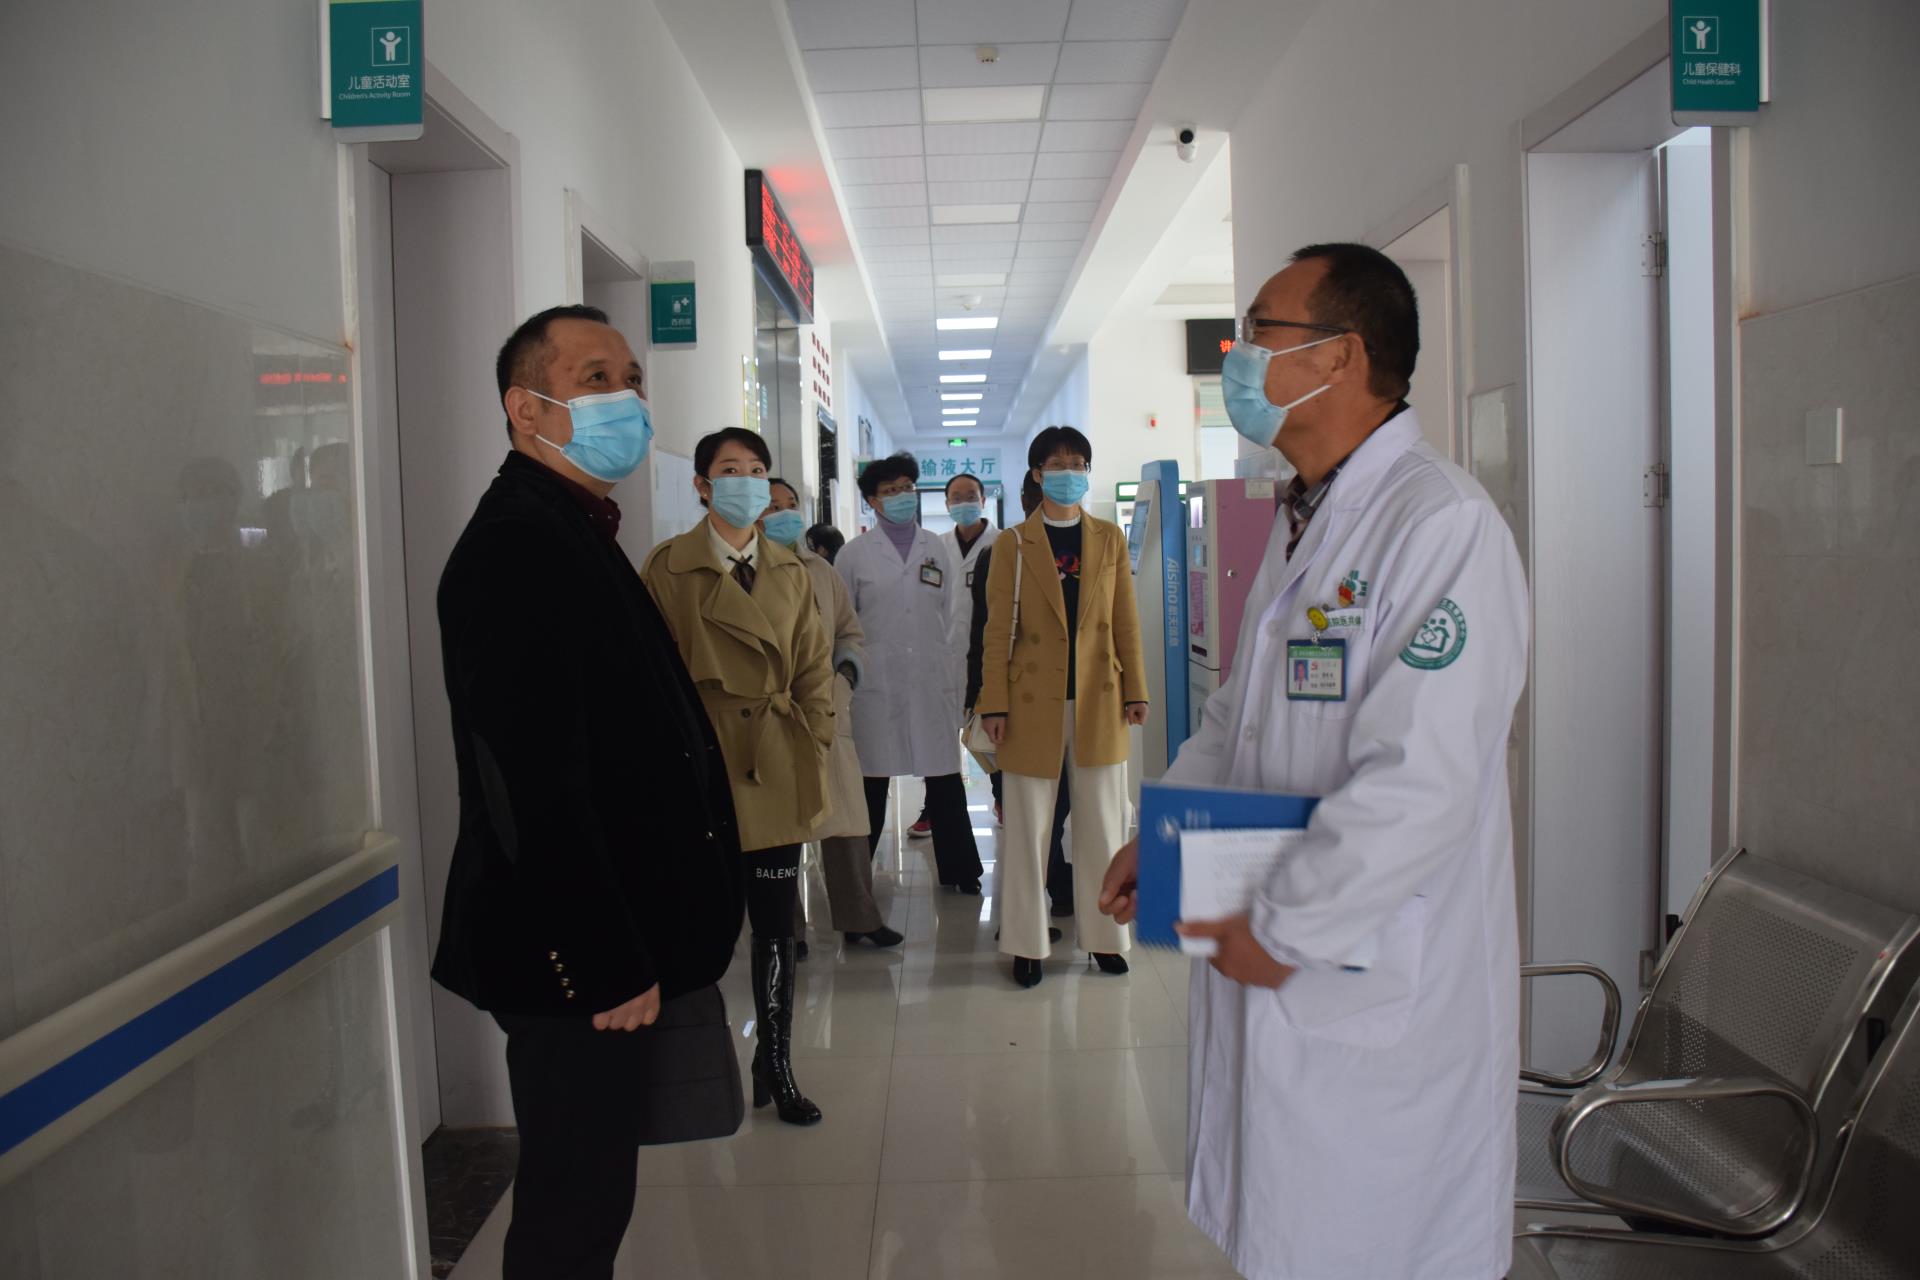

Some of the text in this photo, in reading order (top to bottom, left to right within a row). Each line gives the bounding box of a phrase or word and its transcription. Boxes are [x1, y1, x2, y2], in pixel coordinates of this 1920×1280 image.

[1682, 62, 1741, 76] 儿童保健科
[348, 74, 410, 90] 儿童活动室
[368, 91, 391, 100] Activity
[392, 90, 411, 98] Room
[920, 457, 996, 477] 输液大厅
